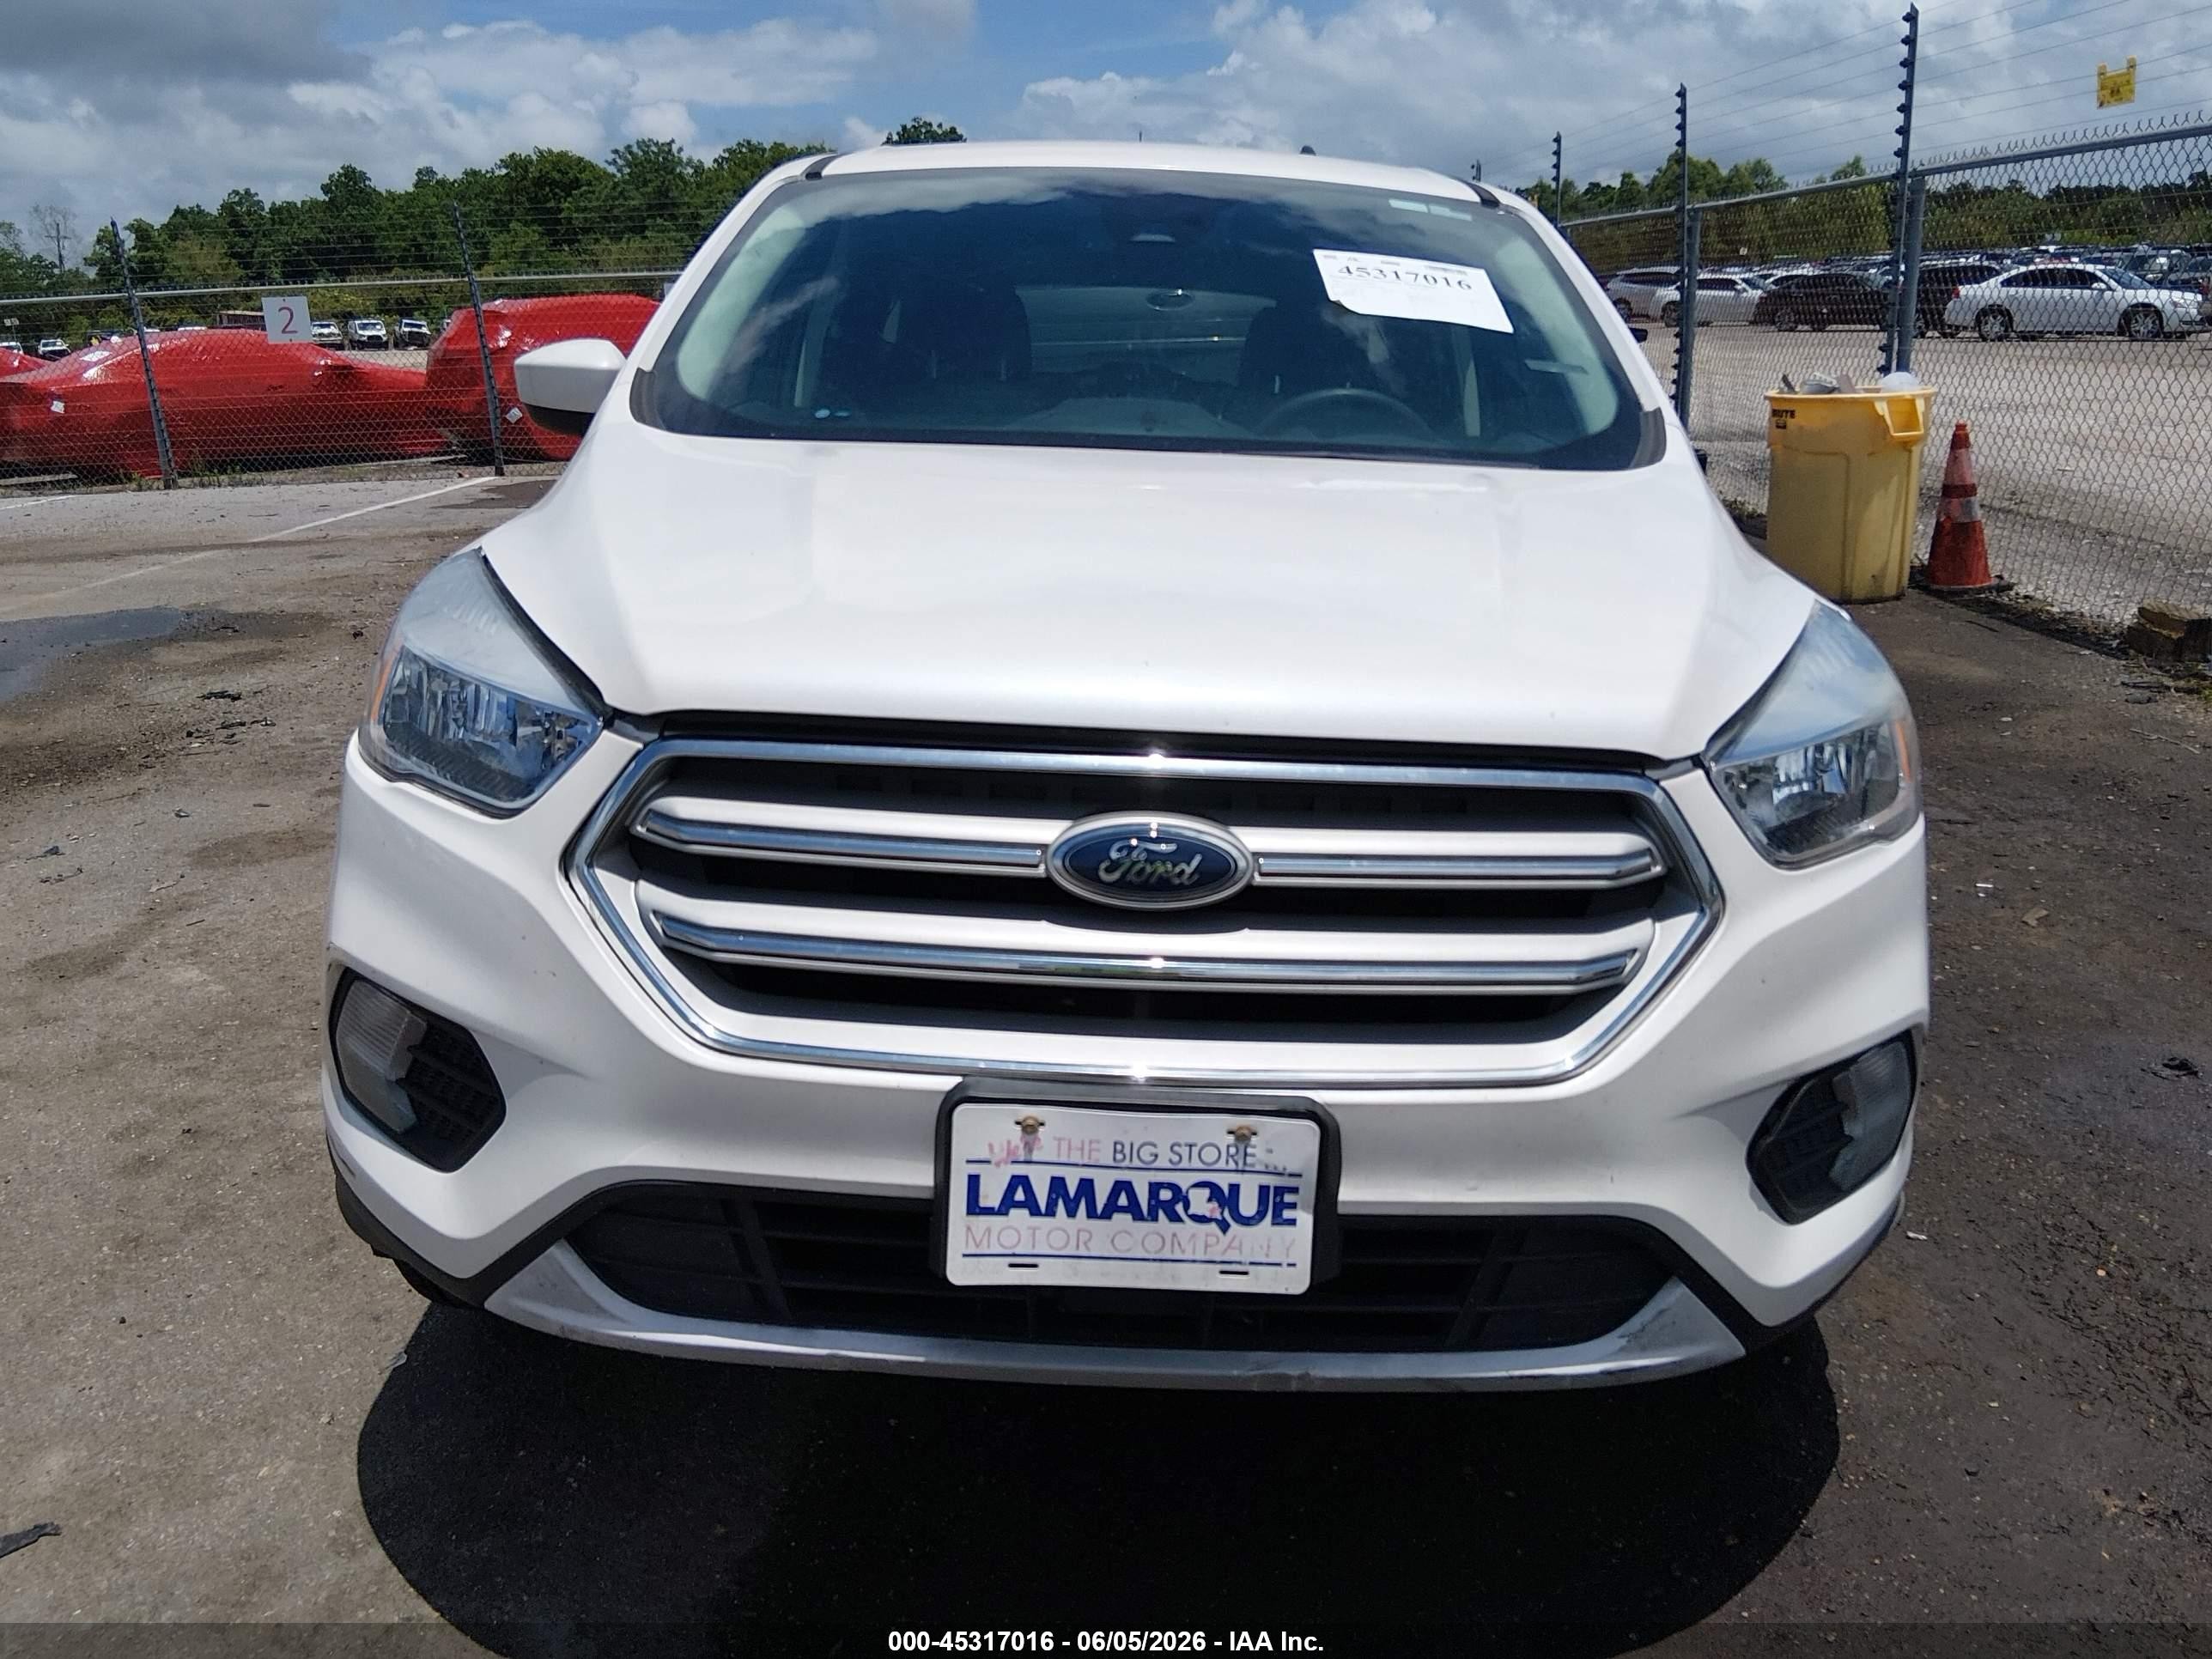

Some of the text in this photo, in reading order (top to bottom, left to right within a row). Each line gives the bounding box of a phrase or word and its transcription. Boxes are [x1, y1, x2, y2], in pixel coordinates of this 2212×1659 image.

[1337, 265, 1473, 291] 45317016
[277, 306, 299, 335] 2
[1097, 839, 1202, 886] Ford
[1053, 1136, 1102, 1164] THE
[1112, 1141, 1159, 1165] BIG
[965, 1173, 1300, 1236] LAMARQUE
[964, 1224, 1297, 1259] MOTOR COMPANY
